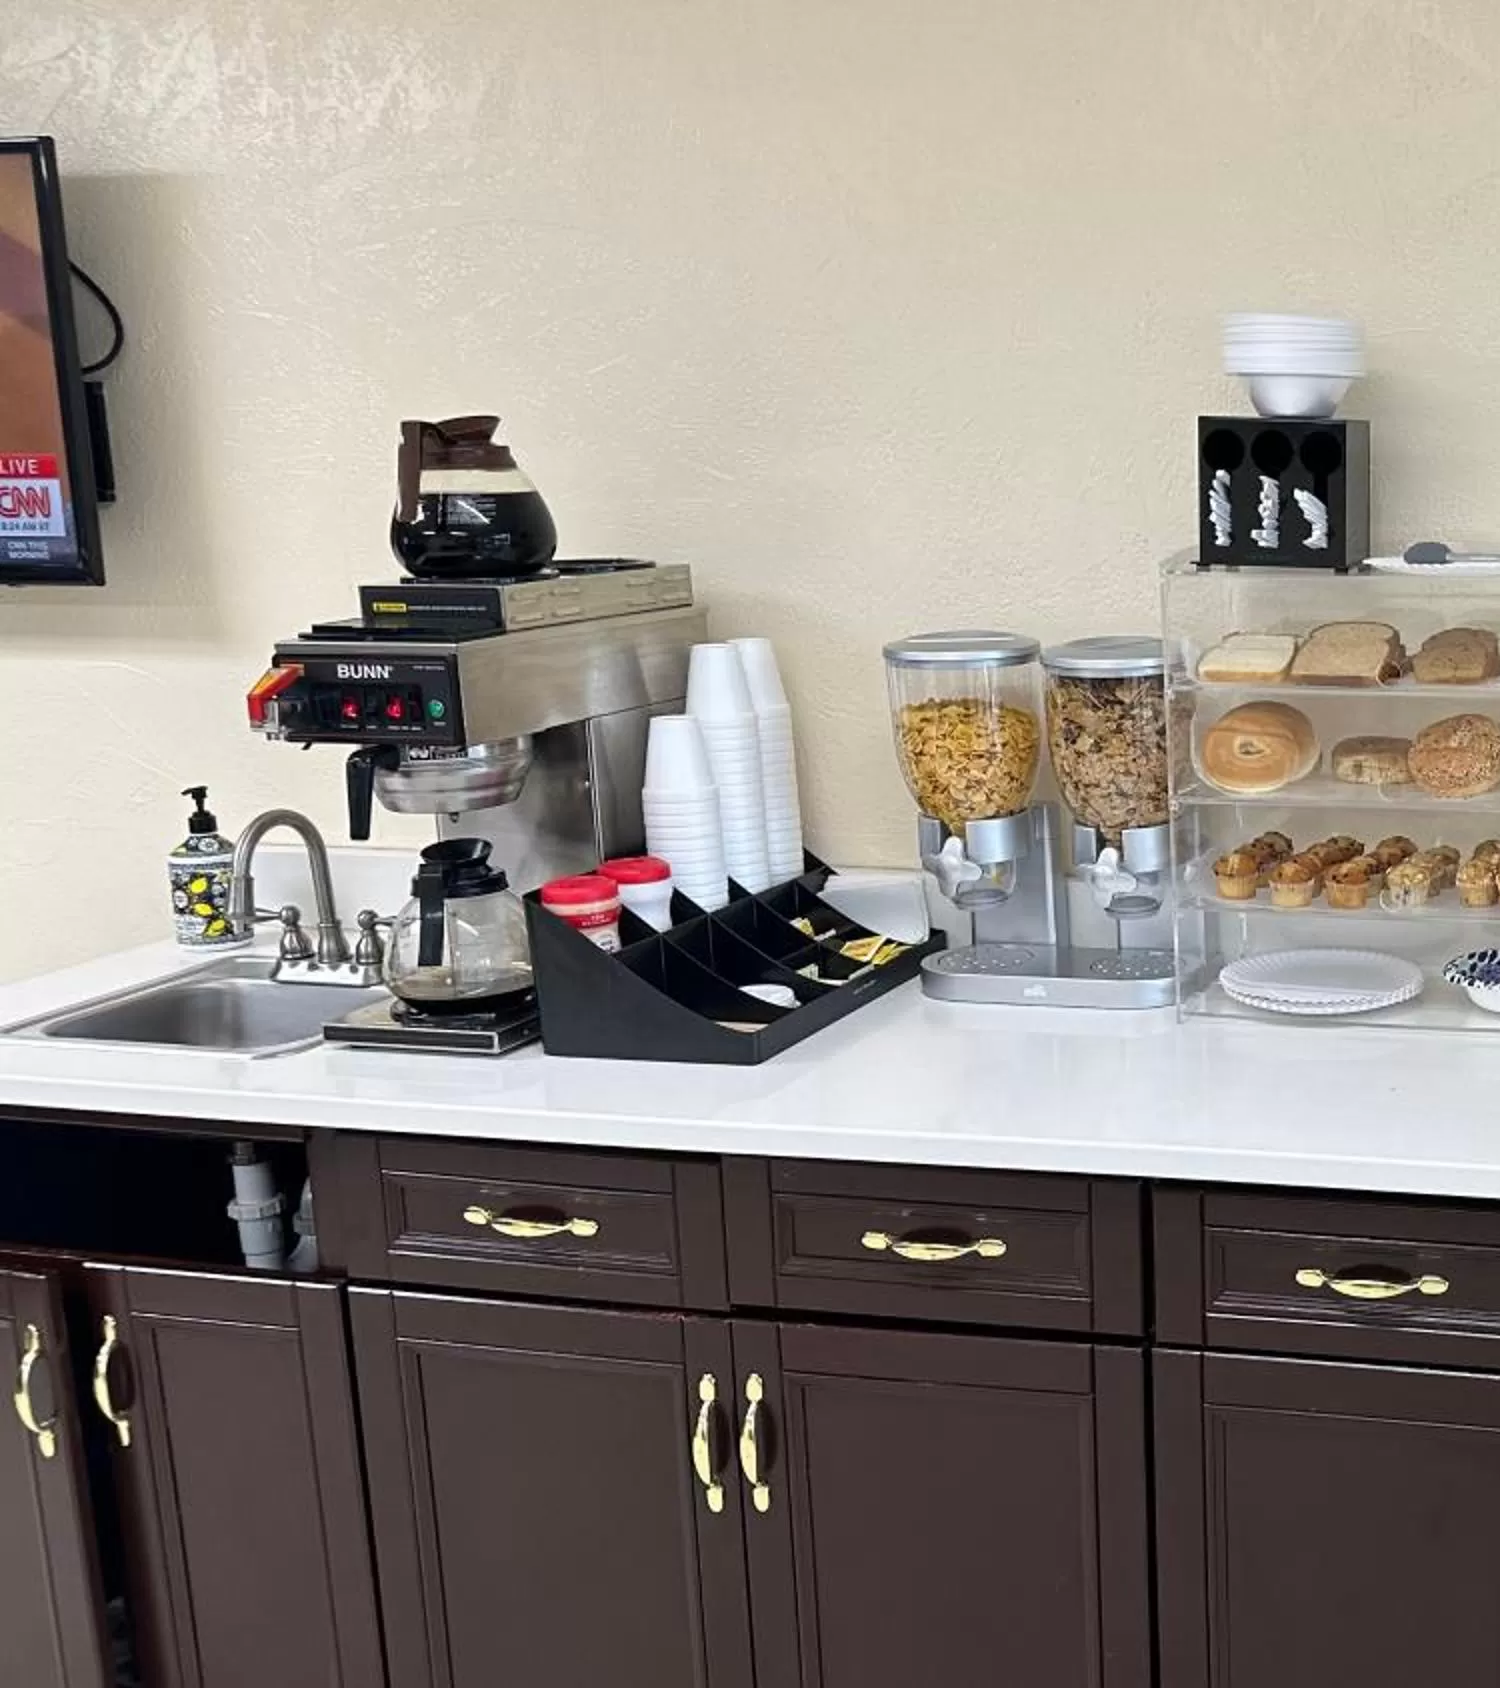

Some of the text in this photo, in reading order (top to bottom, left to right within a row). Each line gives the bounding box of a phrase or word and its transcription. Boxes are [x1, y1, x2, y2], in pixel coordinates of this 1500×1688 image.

[0, 459, 39, 475] LIVE
[0, 486, 51, 518] CNN
[336, 663, 390, 679] BUNN
